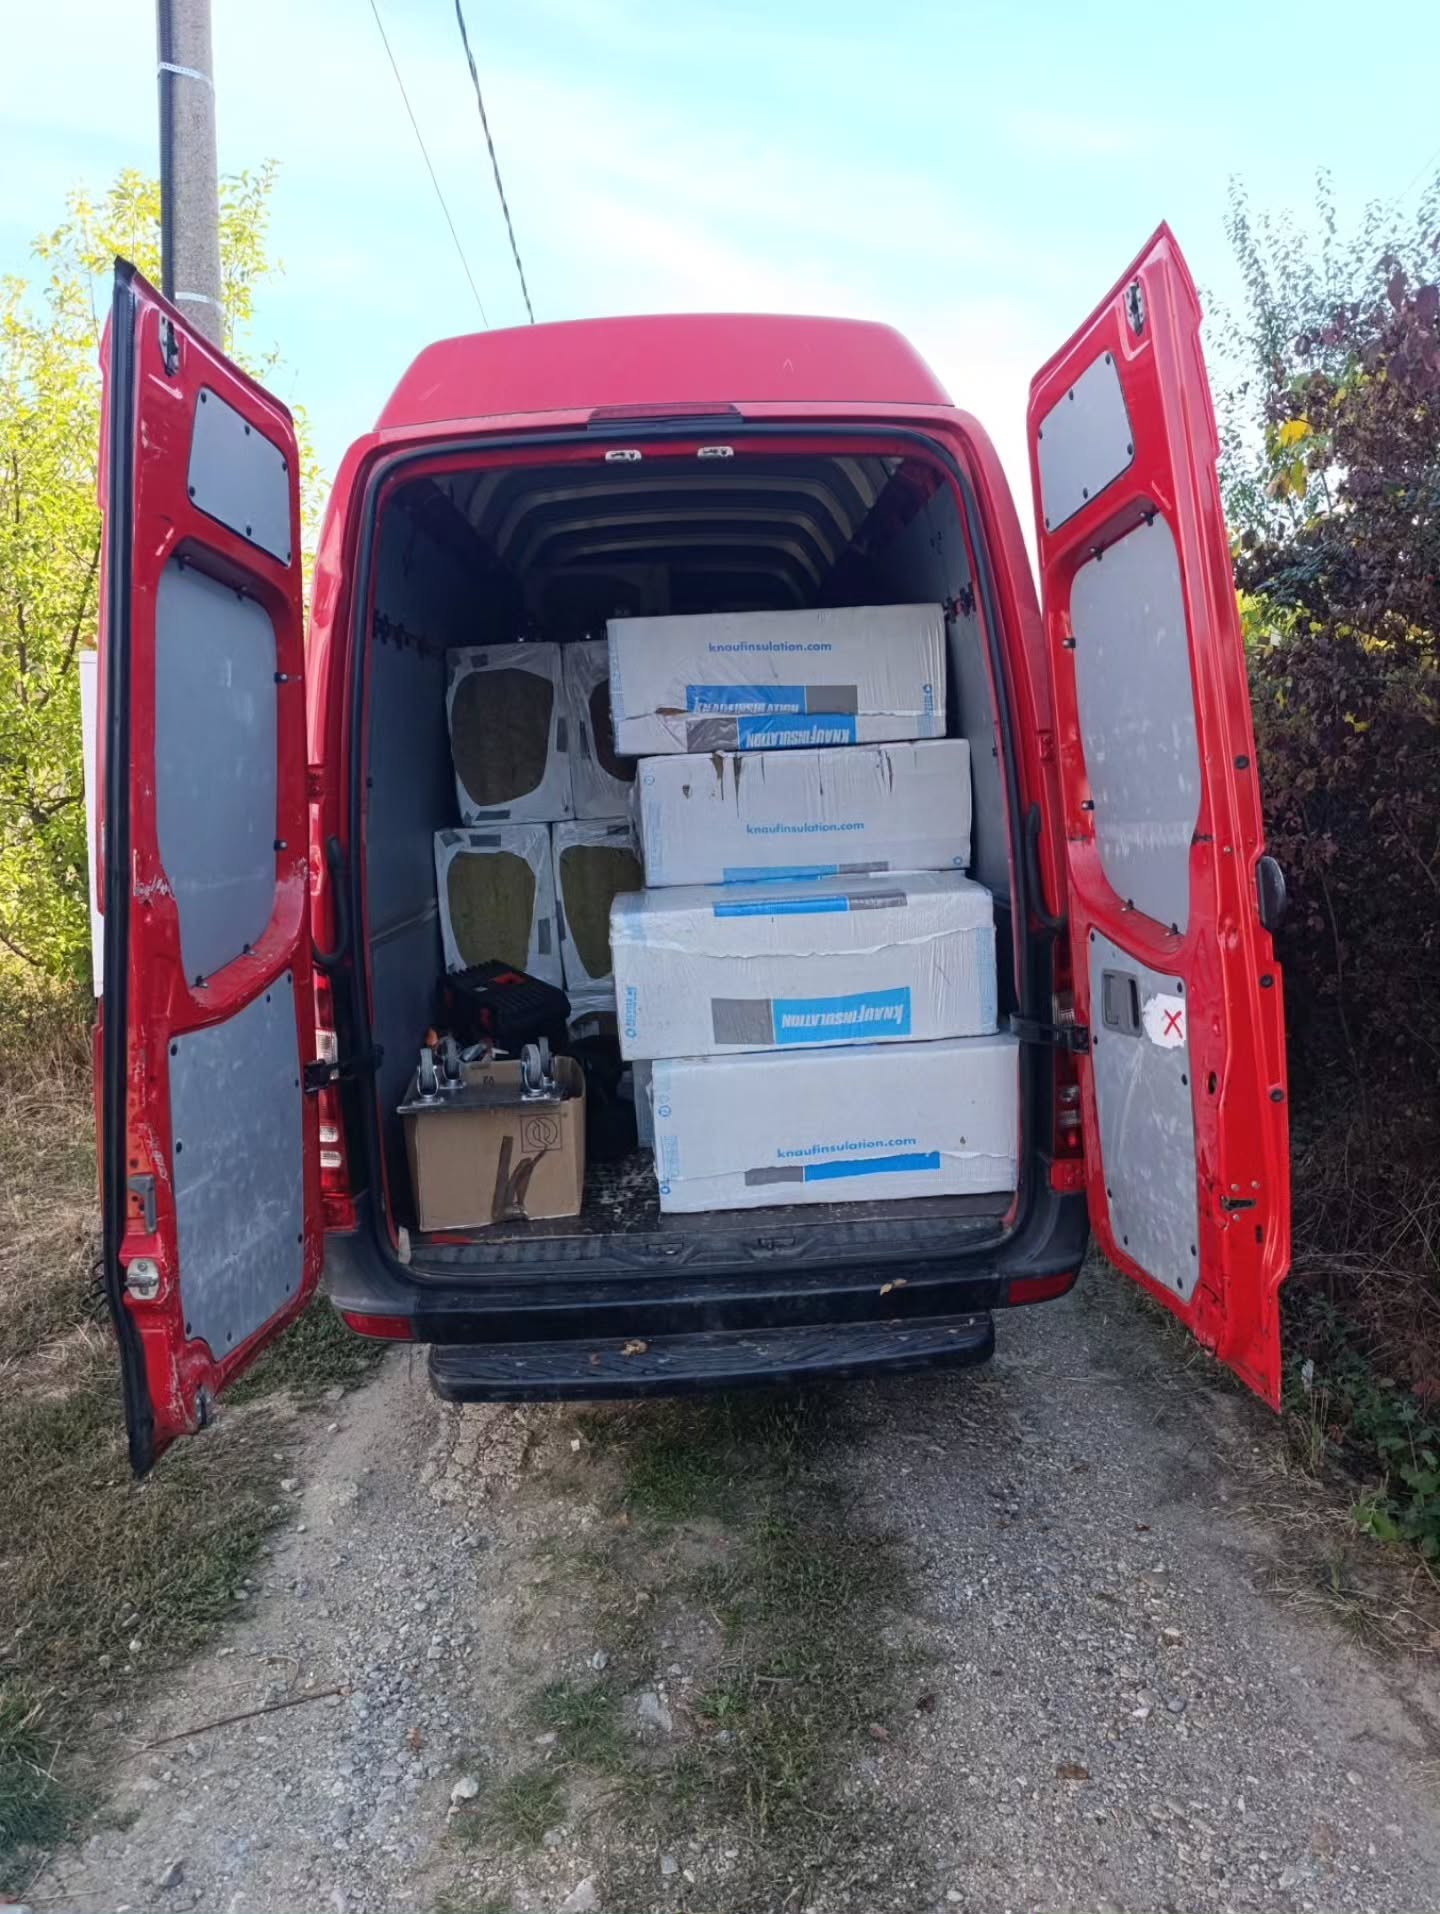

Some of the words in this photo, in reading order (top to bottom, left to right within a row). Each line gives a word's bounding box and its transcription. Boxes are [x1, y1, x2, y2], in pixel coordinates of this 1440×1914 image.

[708, 640, 832, 653] knaufinsulation.com
[746, 821, 865, 834] knaufinsulation.com
[781, 1003, 905, 1029] KNAUFINSULATION
[776, 1136, 917, 1159] knaufinsulation.com
